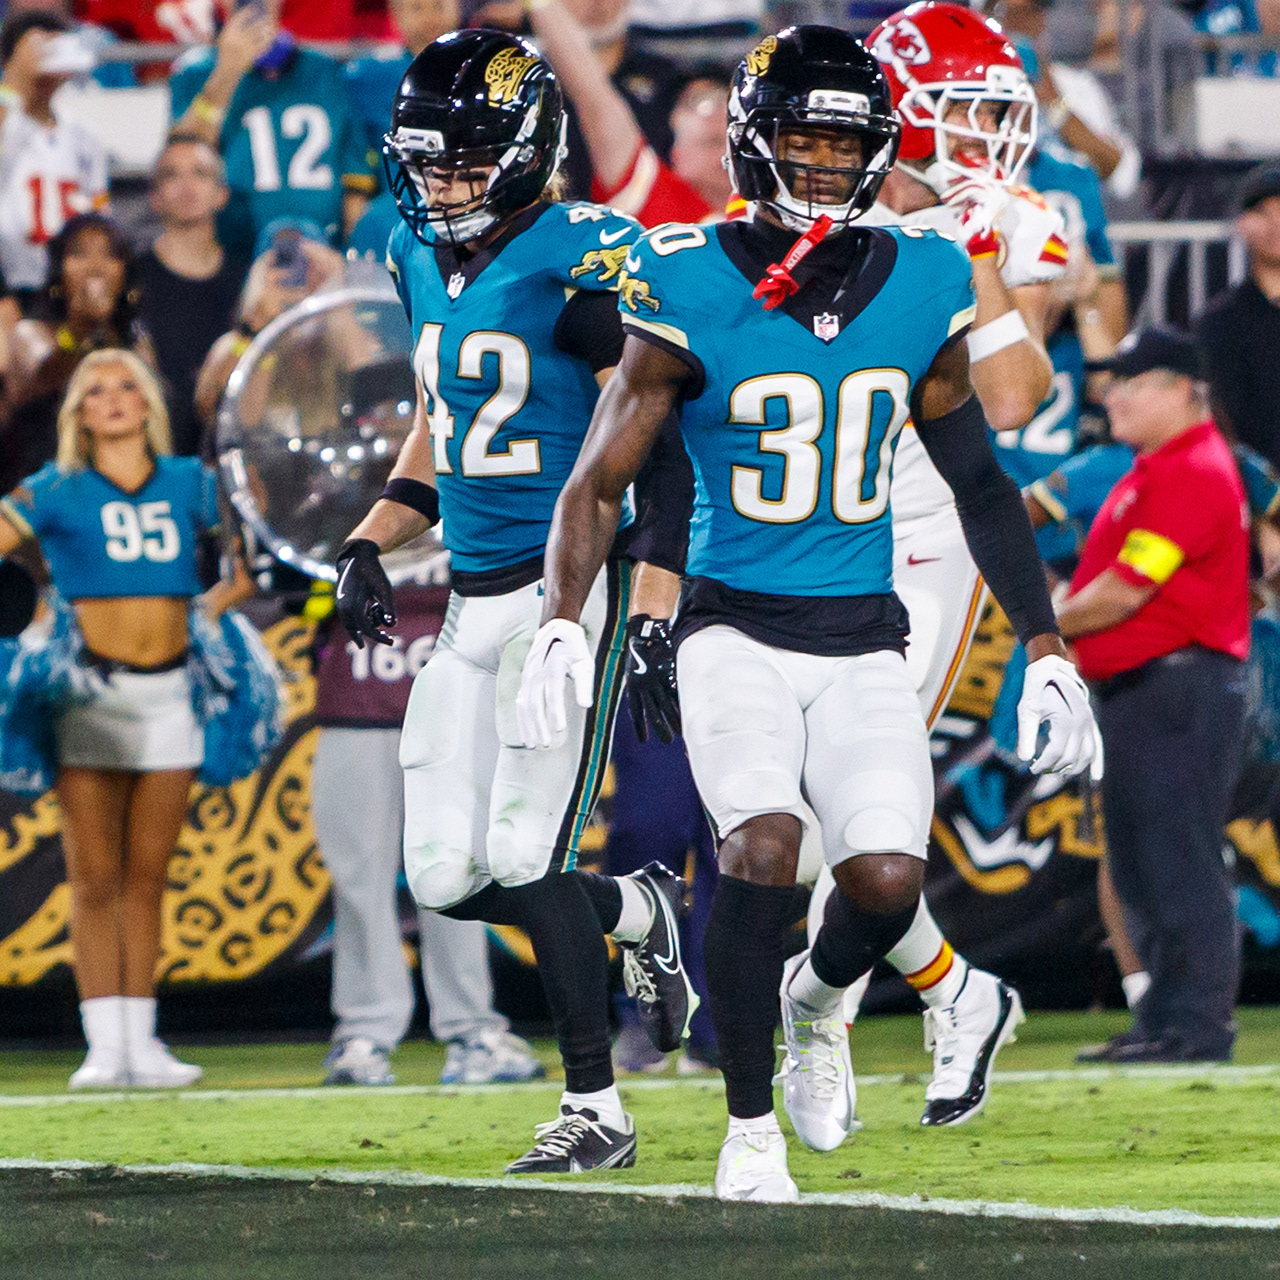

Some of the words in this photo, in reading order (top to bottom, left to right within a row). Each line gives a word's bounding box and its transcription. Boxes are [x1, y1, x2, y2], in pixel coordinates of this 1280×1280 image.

[244, 104, 338, 194] 12
[415, 322, 542, 478] 42
[728, 368, 910, 524] 30
[100, 500, 181, 563] 95
